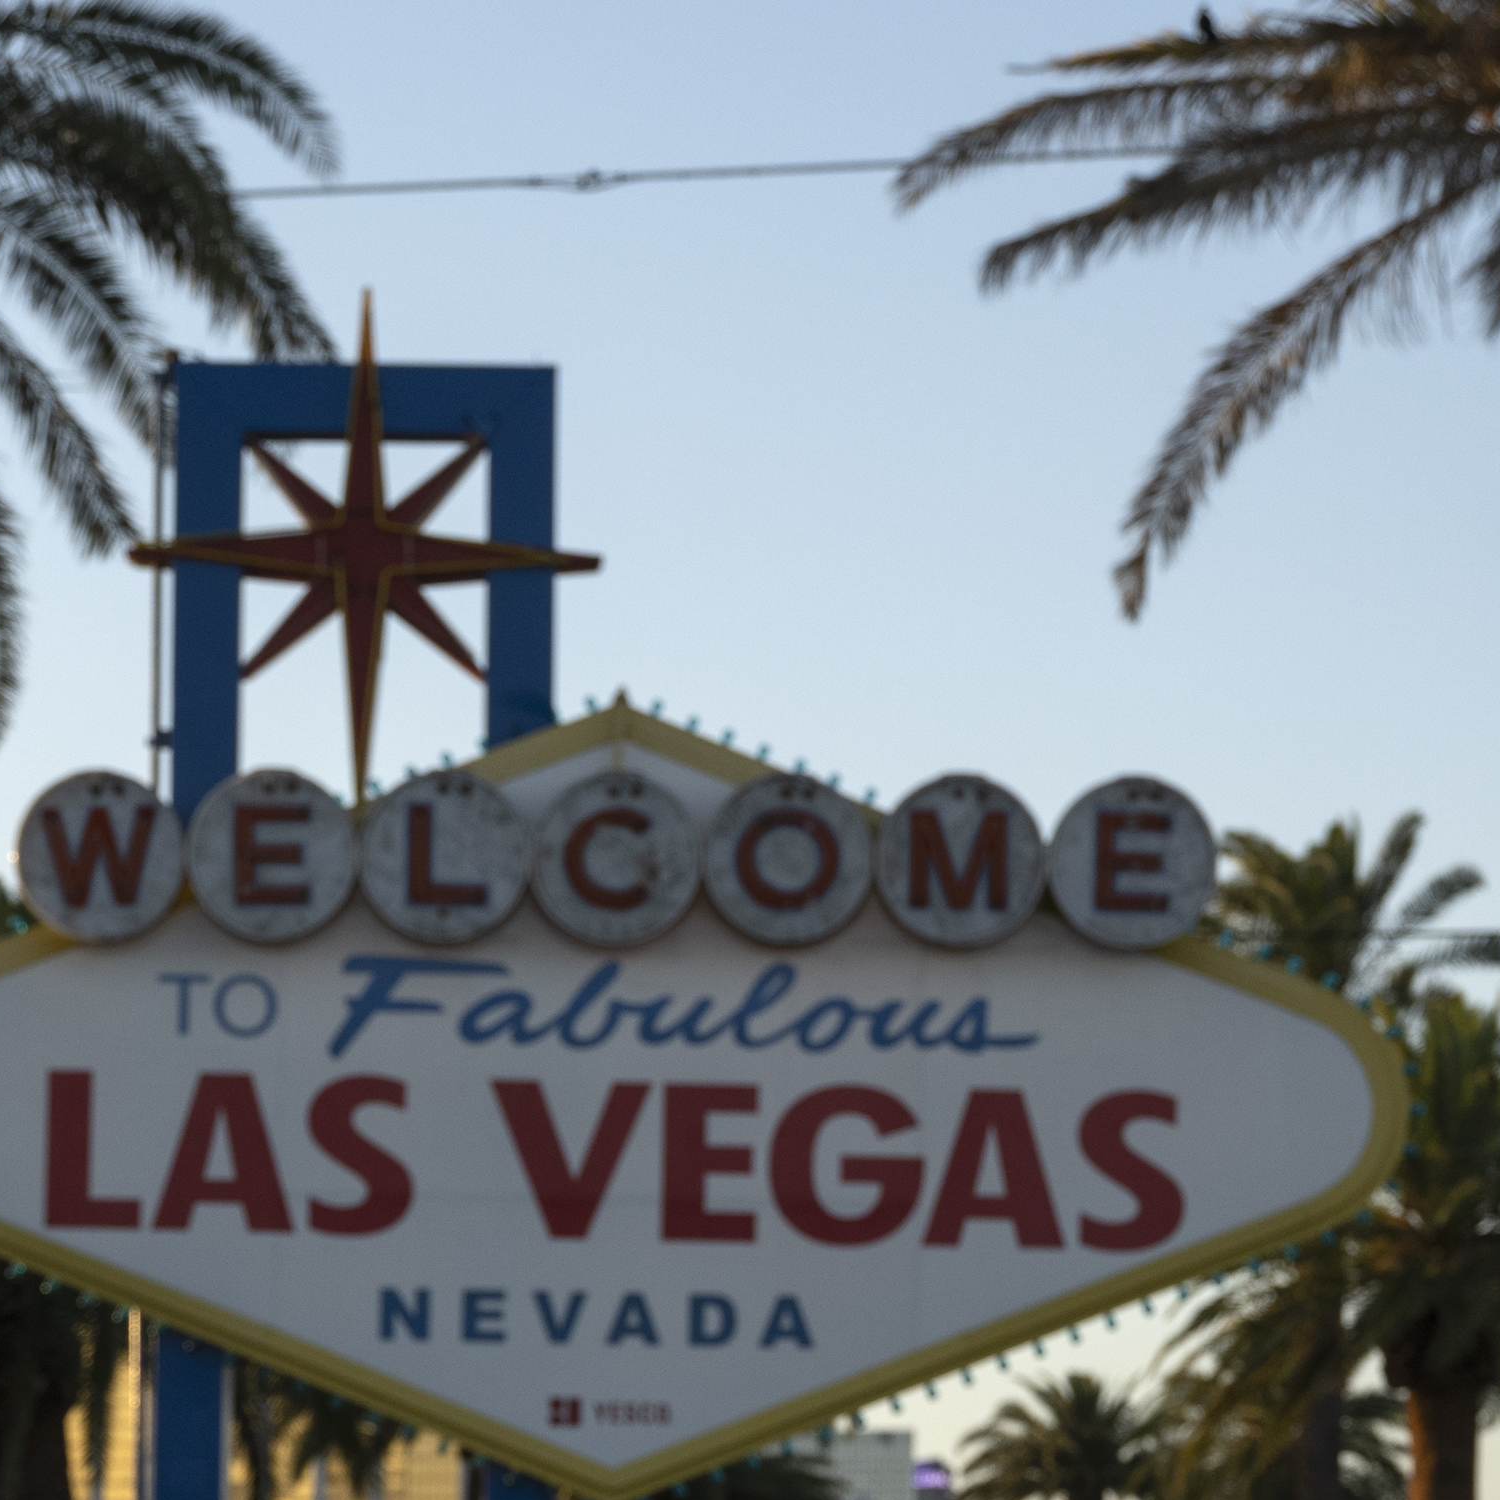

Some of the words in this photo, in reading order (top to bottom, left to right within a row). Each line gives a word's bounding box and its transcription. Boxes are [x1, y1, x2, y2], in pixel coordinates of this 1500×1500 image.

[41, 804, 1172, 912] WELCOME
[158, 972, 279, 1039] TO
[328, 953, 1039, 1059] Fabulous
[43, 1069, 414, 1236] LAS
[491, 1078, 1185, 1251] VEGAS
[377, 1287, 815, 1349] NEVADA
